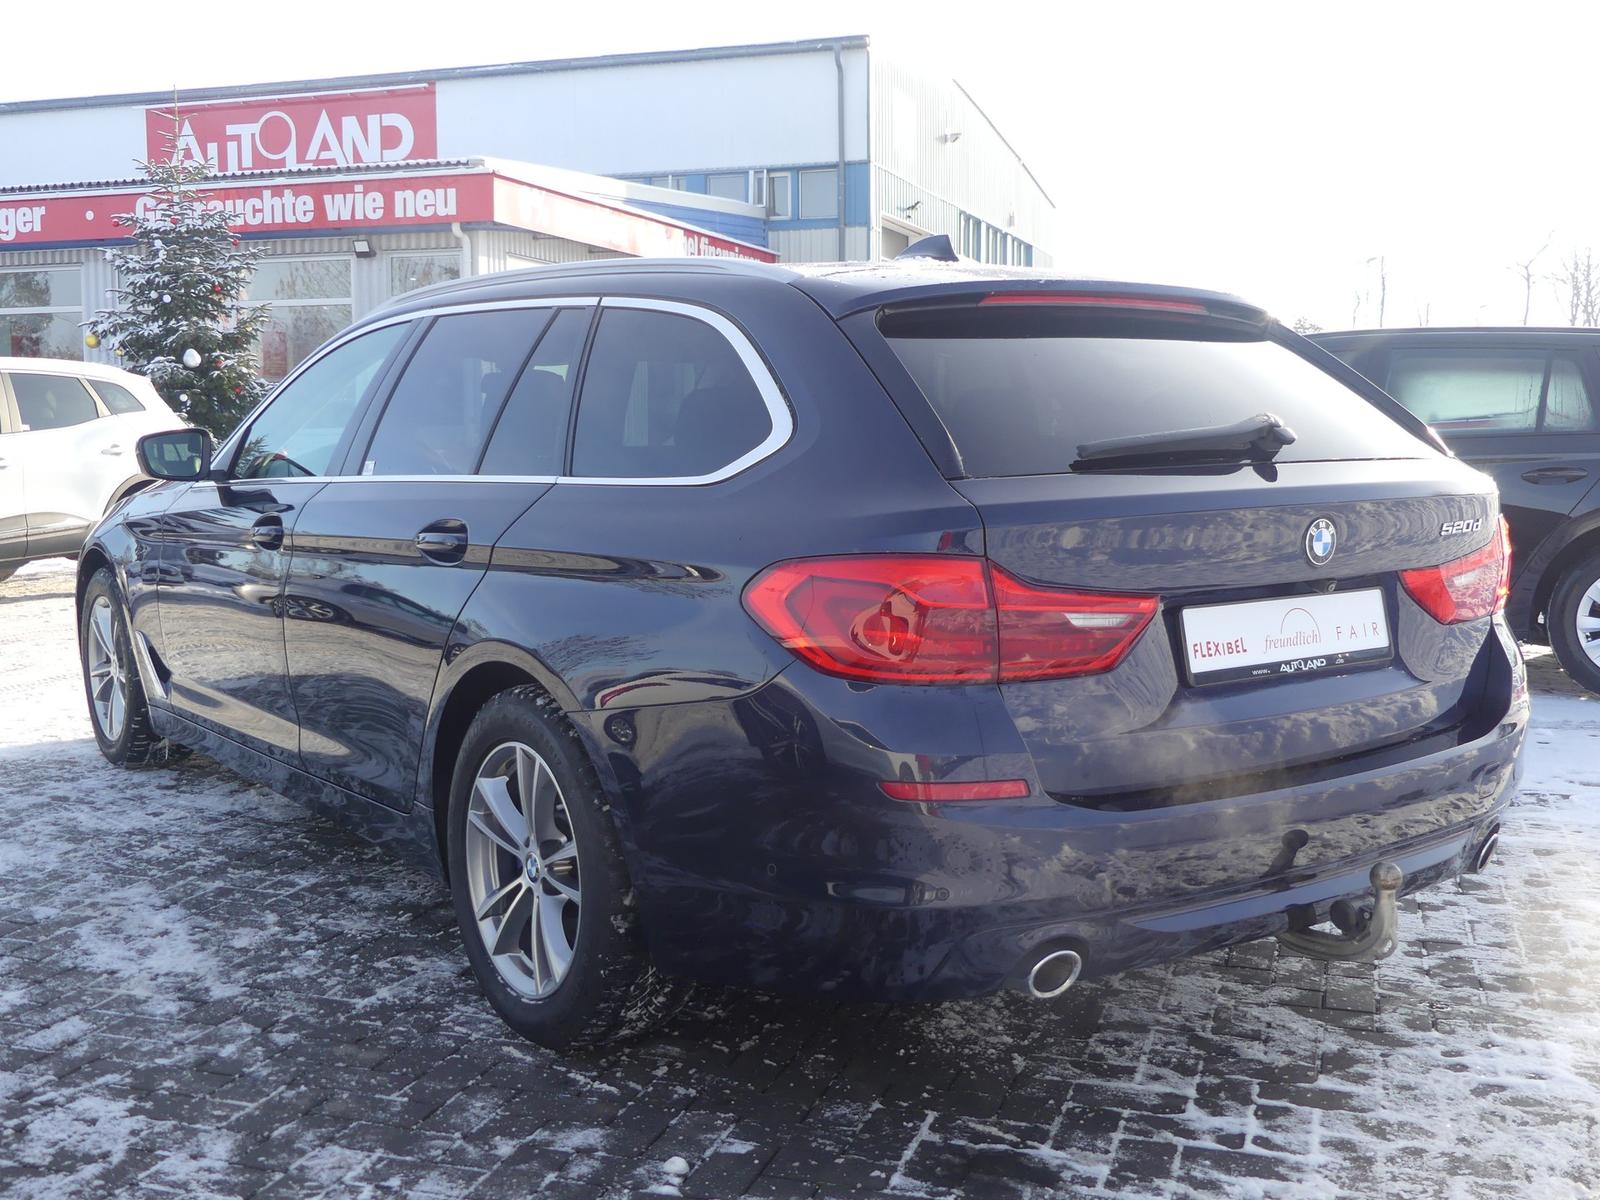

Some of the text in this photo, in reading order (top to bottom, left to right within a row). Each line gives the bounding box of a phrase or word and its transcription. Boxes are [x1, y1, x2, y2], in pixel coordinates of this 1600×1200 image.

[324, 184, 384, 221] wie
[394, 187, 457, 218] neu
[1440, 519, 1482, 537] 520d
[1193, 622, 1380, 659] FLEXIBEL freundlich FAIR
[1280, 658, 1326, 673] AUTOLAND
